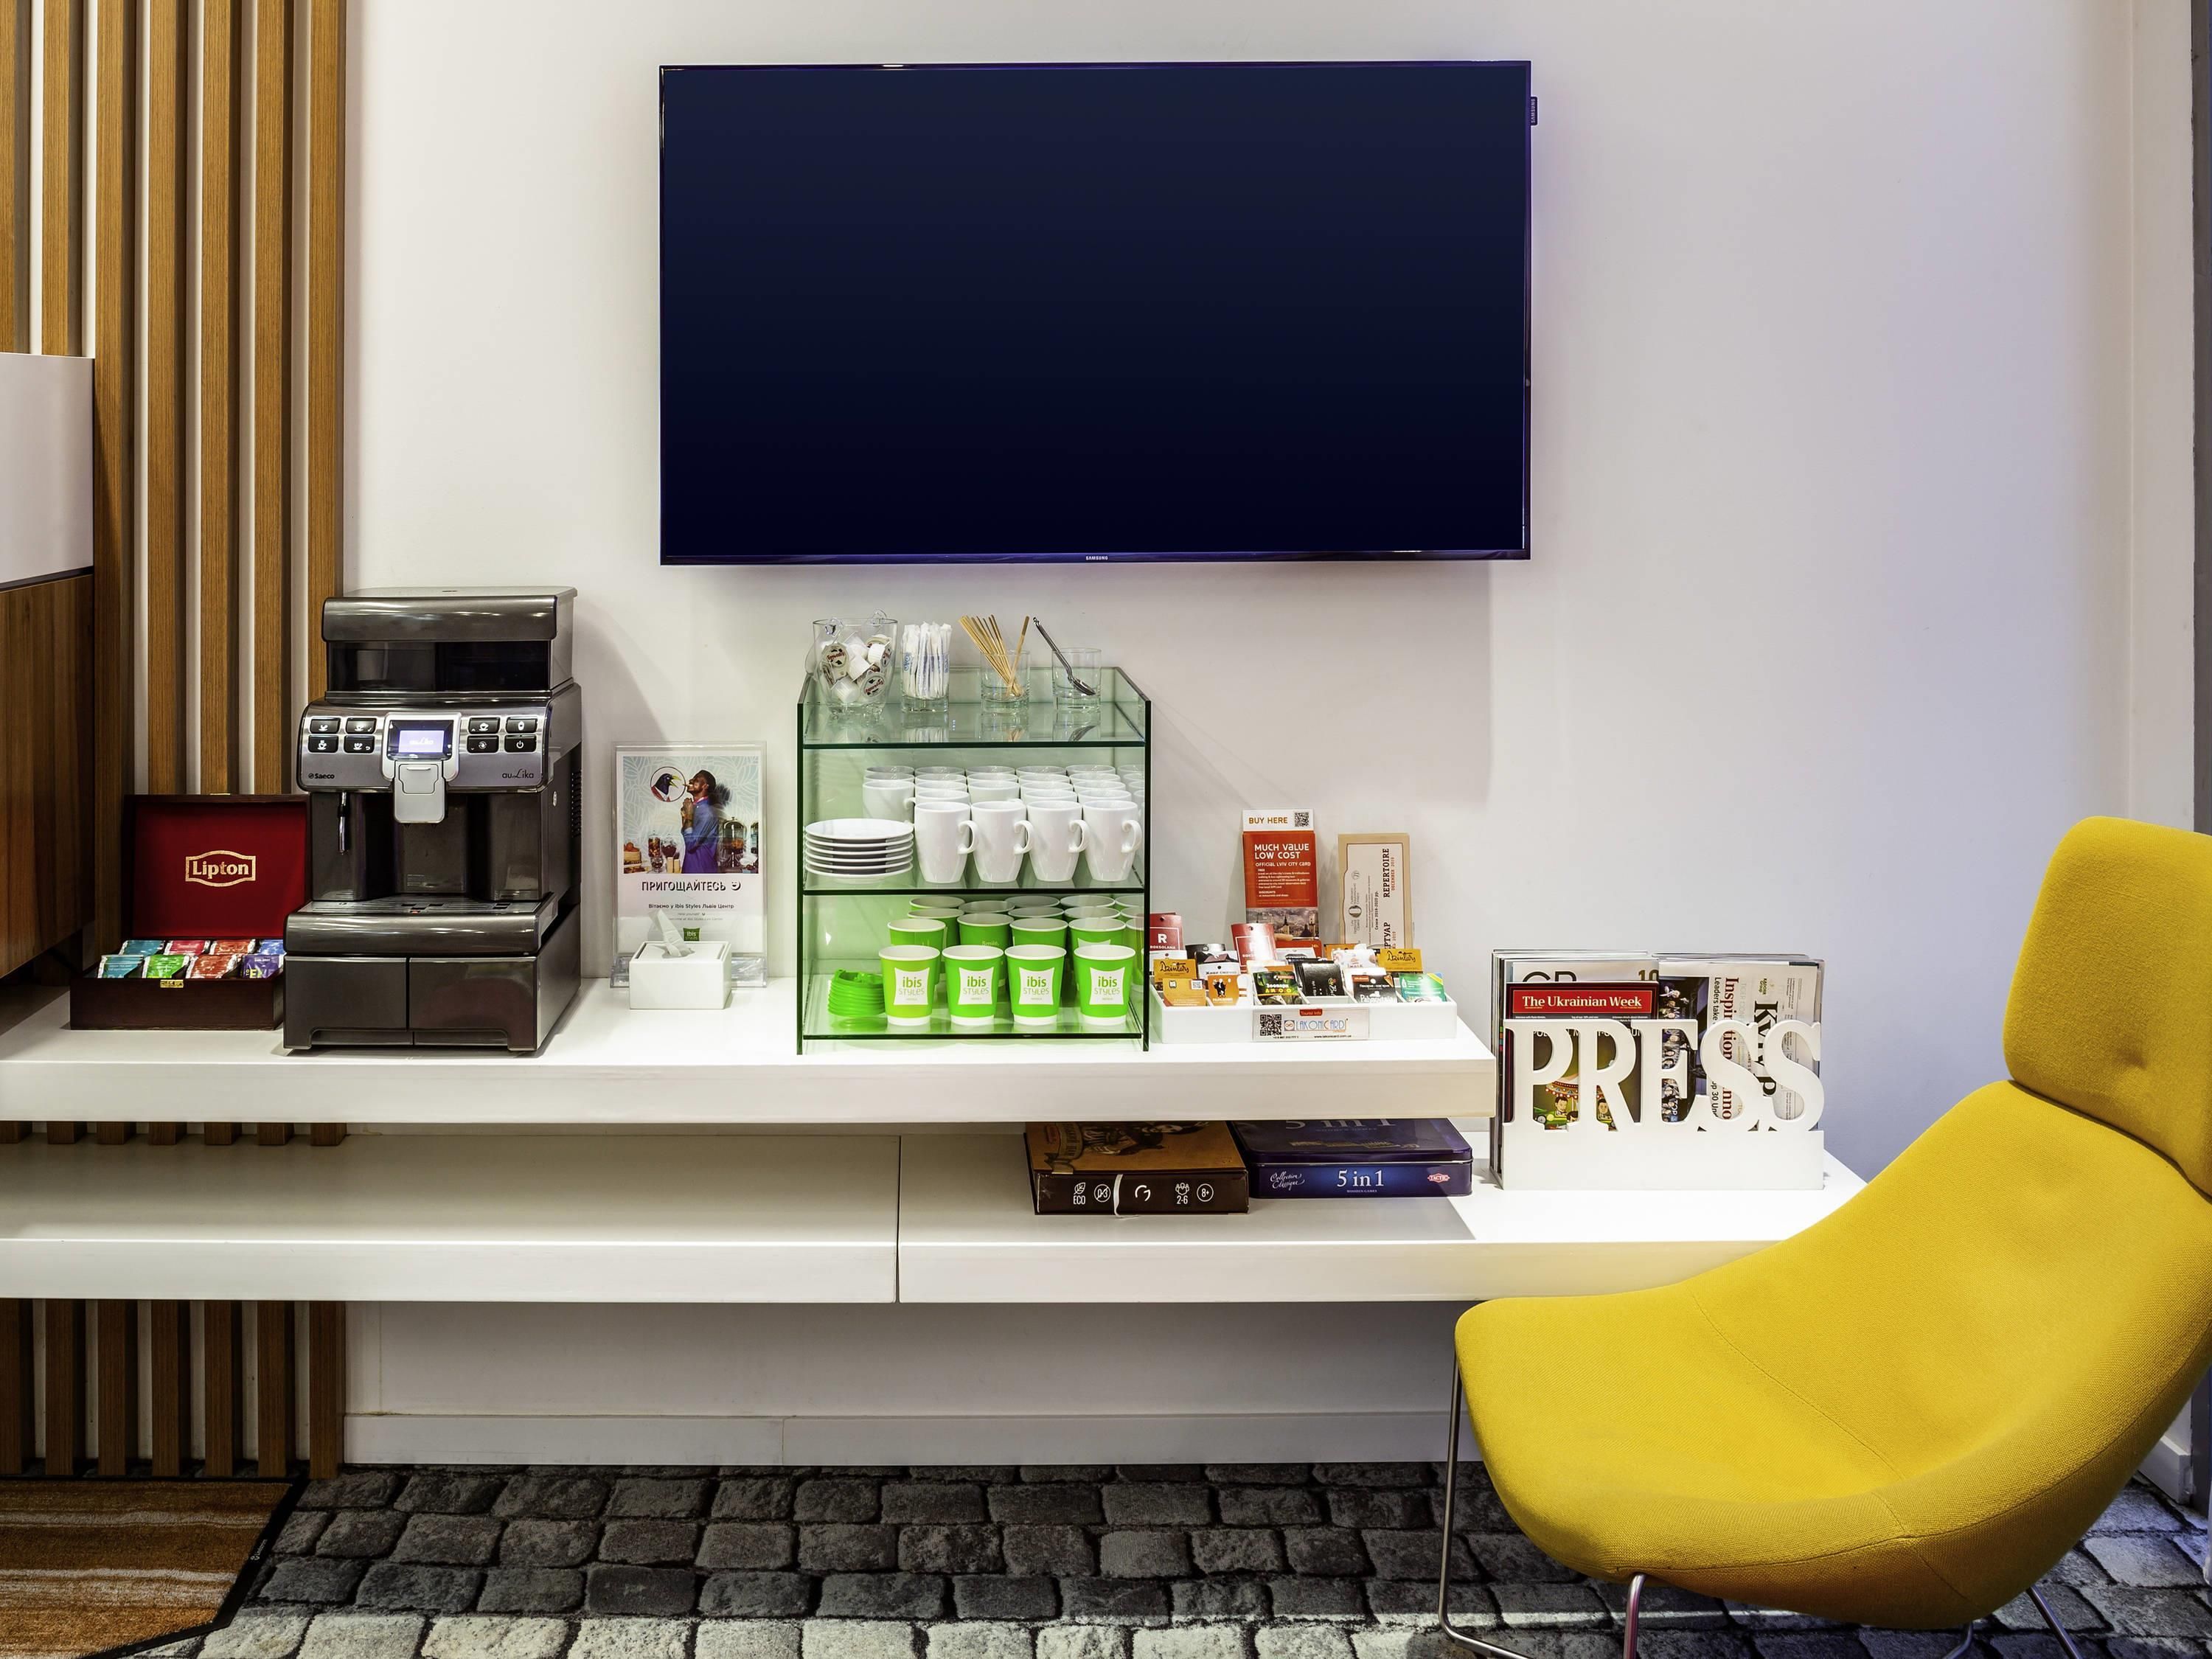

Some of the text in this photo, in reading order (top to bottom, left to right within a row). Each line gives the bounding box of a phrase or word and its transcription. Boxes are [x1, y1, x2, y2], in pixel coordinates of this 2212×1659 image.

[1254, 844, 1279, 852] MUCH
[1254, 852, 1274, 860] LOW
[192, 860, 249, 880] Lipton
[1382, 848, 1391, 898] REPERTOIRE
[641, 880, 726, 892] ПРИГОЩАЙТЕСЬ
[1158, 933, 1167, 944] R
[902, 976, 922, 988] ibis
[967, 975, 987, 987] ibis
[1026, 975, 1047, 987] ibis
[1098, 975, 1118, 987] ibis
[1522, 995, 1642, 1007] The Ukrainian Week
[1712, 977, 1722, 1020] Leaders take
[1503, 1019, 1825, 1132] PRESS
[1711, 1091, 1719, 1101] 30
[1337, 1169, 1385, 1187] 5 in 1
[1200, 1189, 1210, 1197] 8+
[1073, 1194, 1086, 1205] ECO
[1176, 1194, 1189, 1205] 2-6
